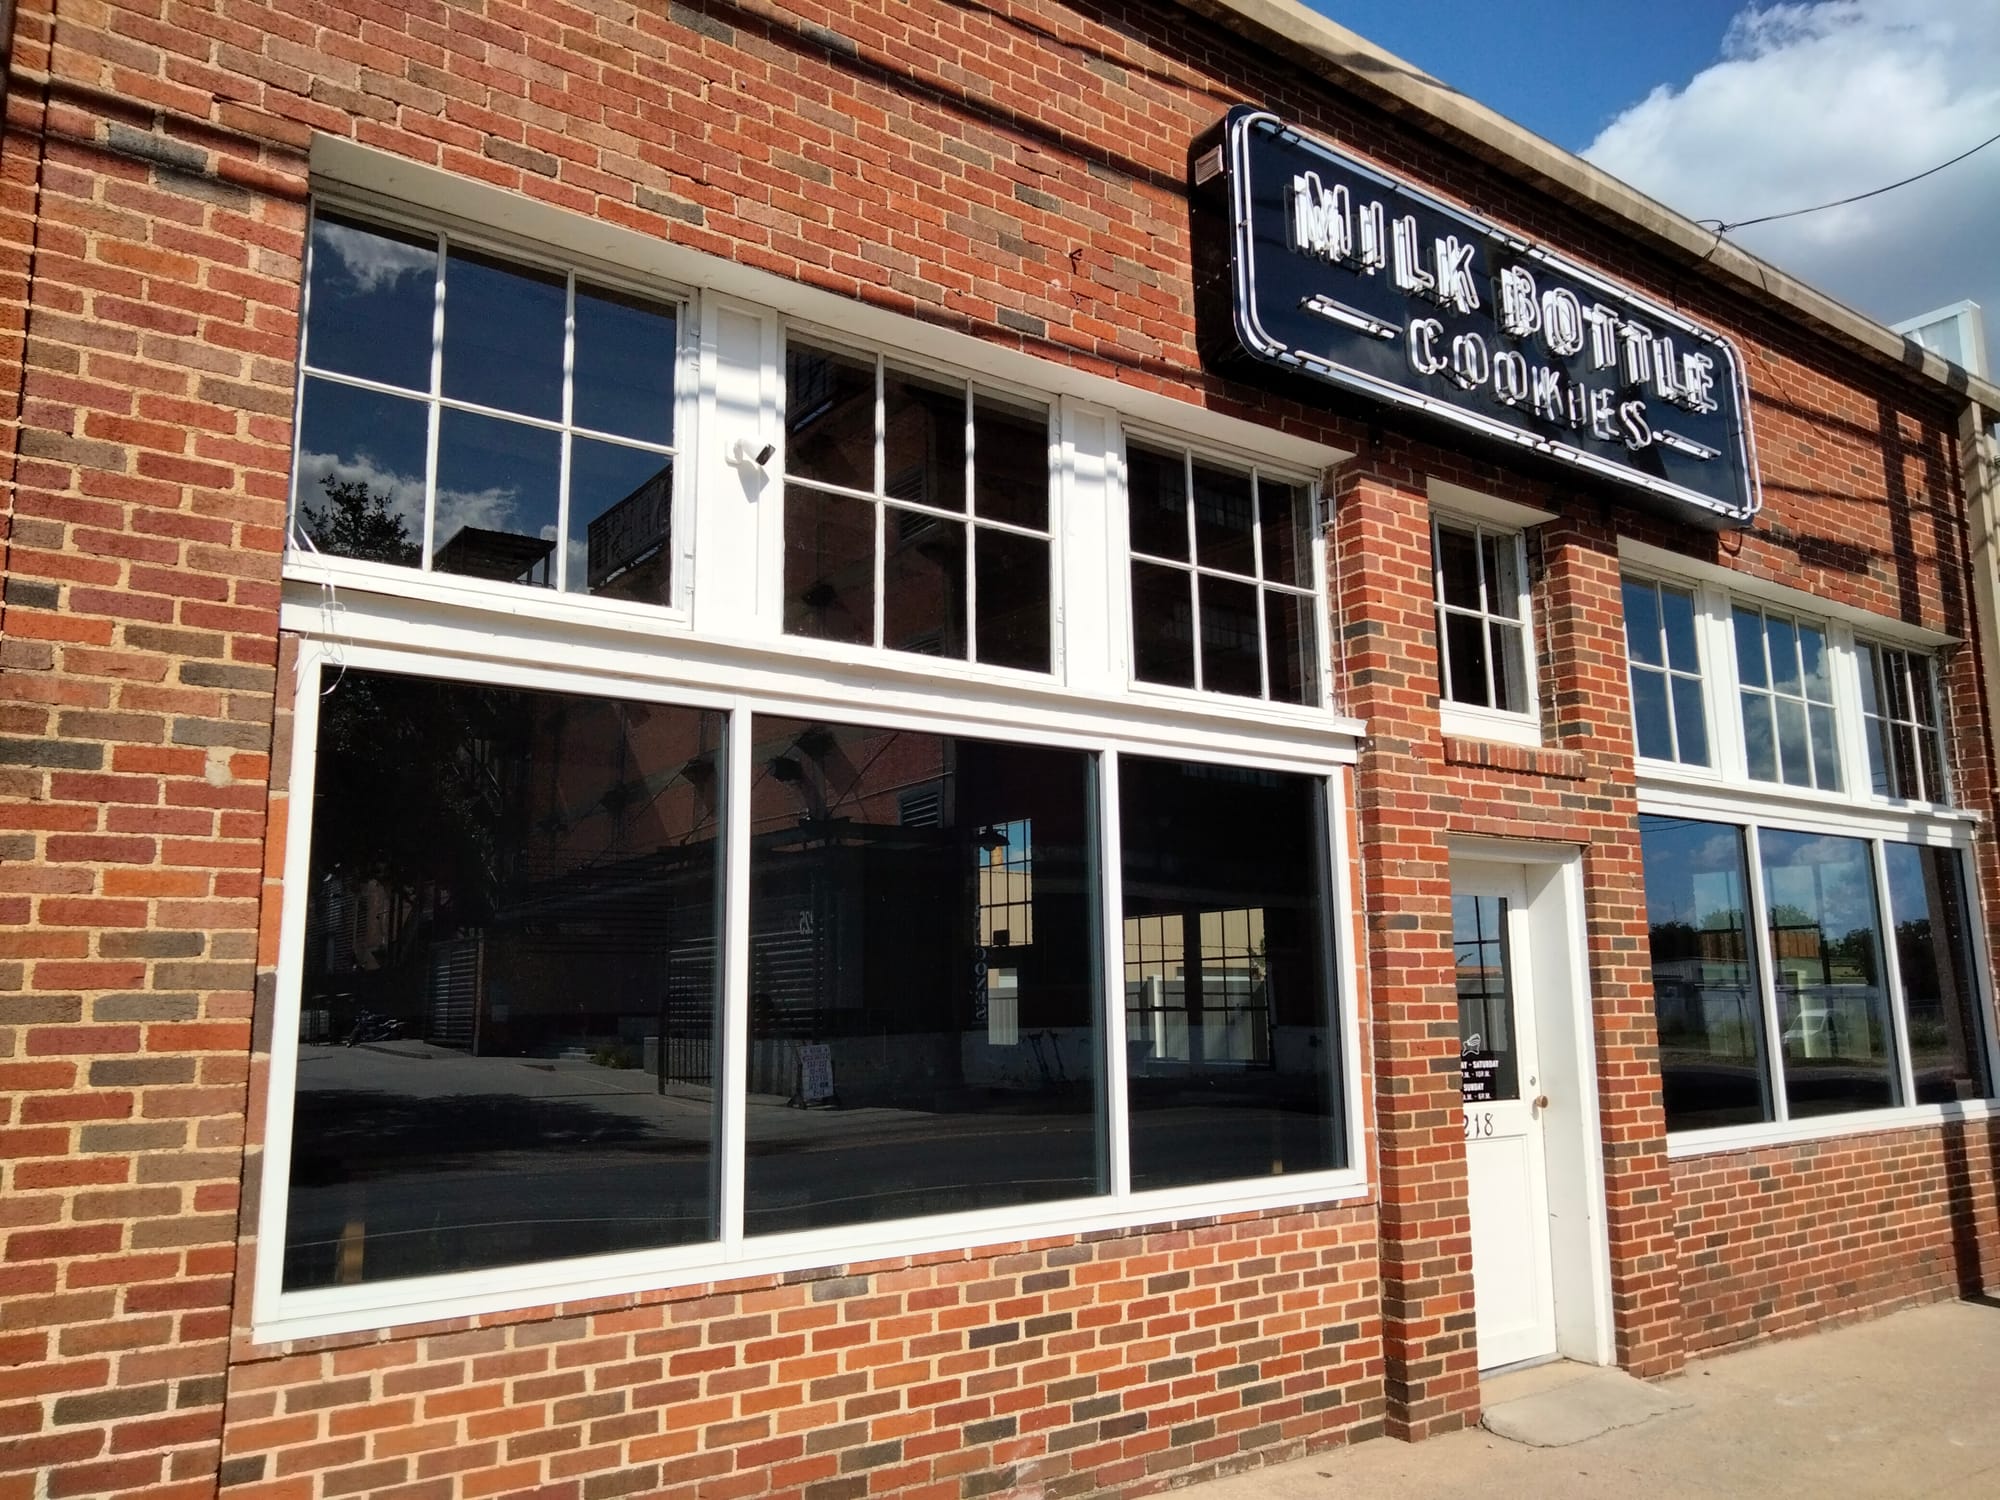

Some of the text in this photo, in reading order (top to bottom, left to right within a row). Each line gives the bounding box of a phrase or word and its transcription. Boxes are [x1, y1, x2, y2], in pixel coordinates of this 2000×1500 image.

[1292, 171, 1719, 415] MILK BOTTLE
[1410, 317, 1652, 452] COOKIES
[1472, 1060, 1499, 1069] SATURDAY
